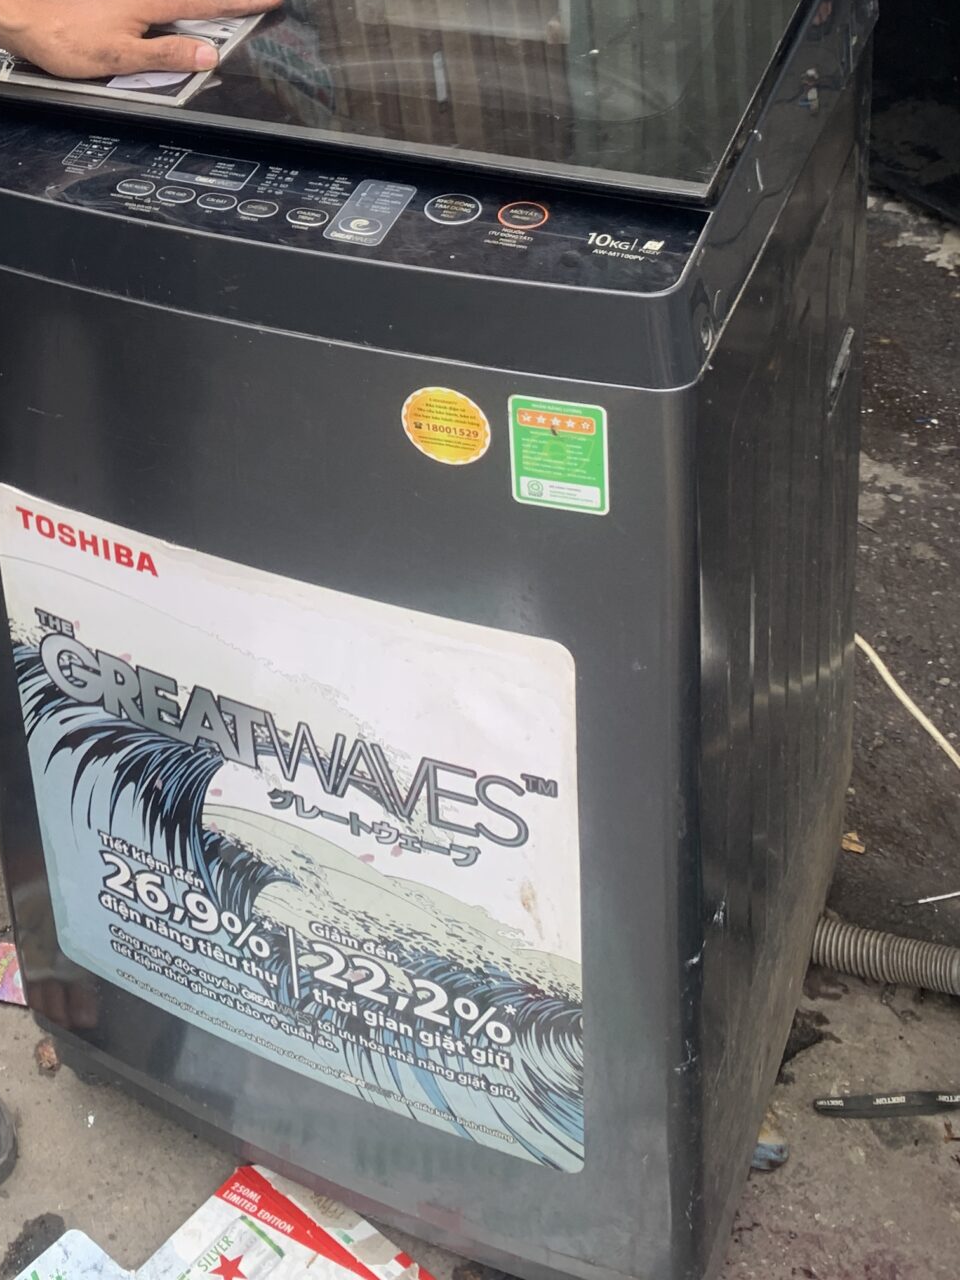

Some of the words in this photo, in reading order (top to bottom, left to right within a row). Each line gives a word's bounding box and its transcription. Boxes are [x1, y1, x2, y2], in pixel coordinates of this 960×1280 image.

[426, 423, 479, 439] 18001529
[16, 506, 159, 577] TOSHIBA
[34, 607, 75, 637] THE
[266, 787, 481, 867] グレートウェーブ
[100, 831, 129, 857] Tiết
[131, 847, 171, 875] kiệm
[174, 865, 205, 889] đến
[100, 893, 141, 923] điện
[145, 916, 195, 951] năng
[198, 940, 238, 968] tiêu
[241, 959, 278, 987] thụ
[310, 922, 359, 949] Giảm
[363, 940, 399, 963] đến
[112, 924, 140, 950] Công
[143, 942, 172, 965] nghệ
[174, 957, 198, 978] độc
[199, 972, 238, 995] quyền
[317, 1019, 336, 1036] tối
[338, 1029, 356, 1043] ưu
[359, 1036, 385, 1053] hóa
[388, 1045, 415, 1064] khả
[418, 1059, 454, 1081] năng
[458, 1072, 487, 1091] giặt
[113, 941, 133, 960] tiết
[134, 952, 163, 975] kiệm
[164, 967, 189, 986] thời
[190, 982, 218, 1001] gian
[219, 992, 235, 1007] và
[236, 999, 261, 1019] bảo
[263, 1012, 279, 1030] vệ
[281, 1020, 315, 1043] quần
[318, 1035, 338, 1053] áo.
[313, 988, 358, 1017] thời
[363, 1010, 413, 1038] gian
[419, 1029, 466, 1058] giặt
[222, 1190, 258, 1214] LIMITED
[257, 1208, 295, 1235] EDITION
[230, 1181, 262, 1205] 250ML
[195, 1234, 235, 1274] SILVER
